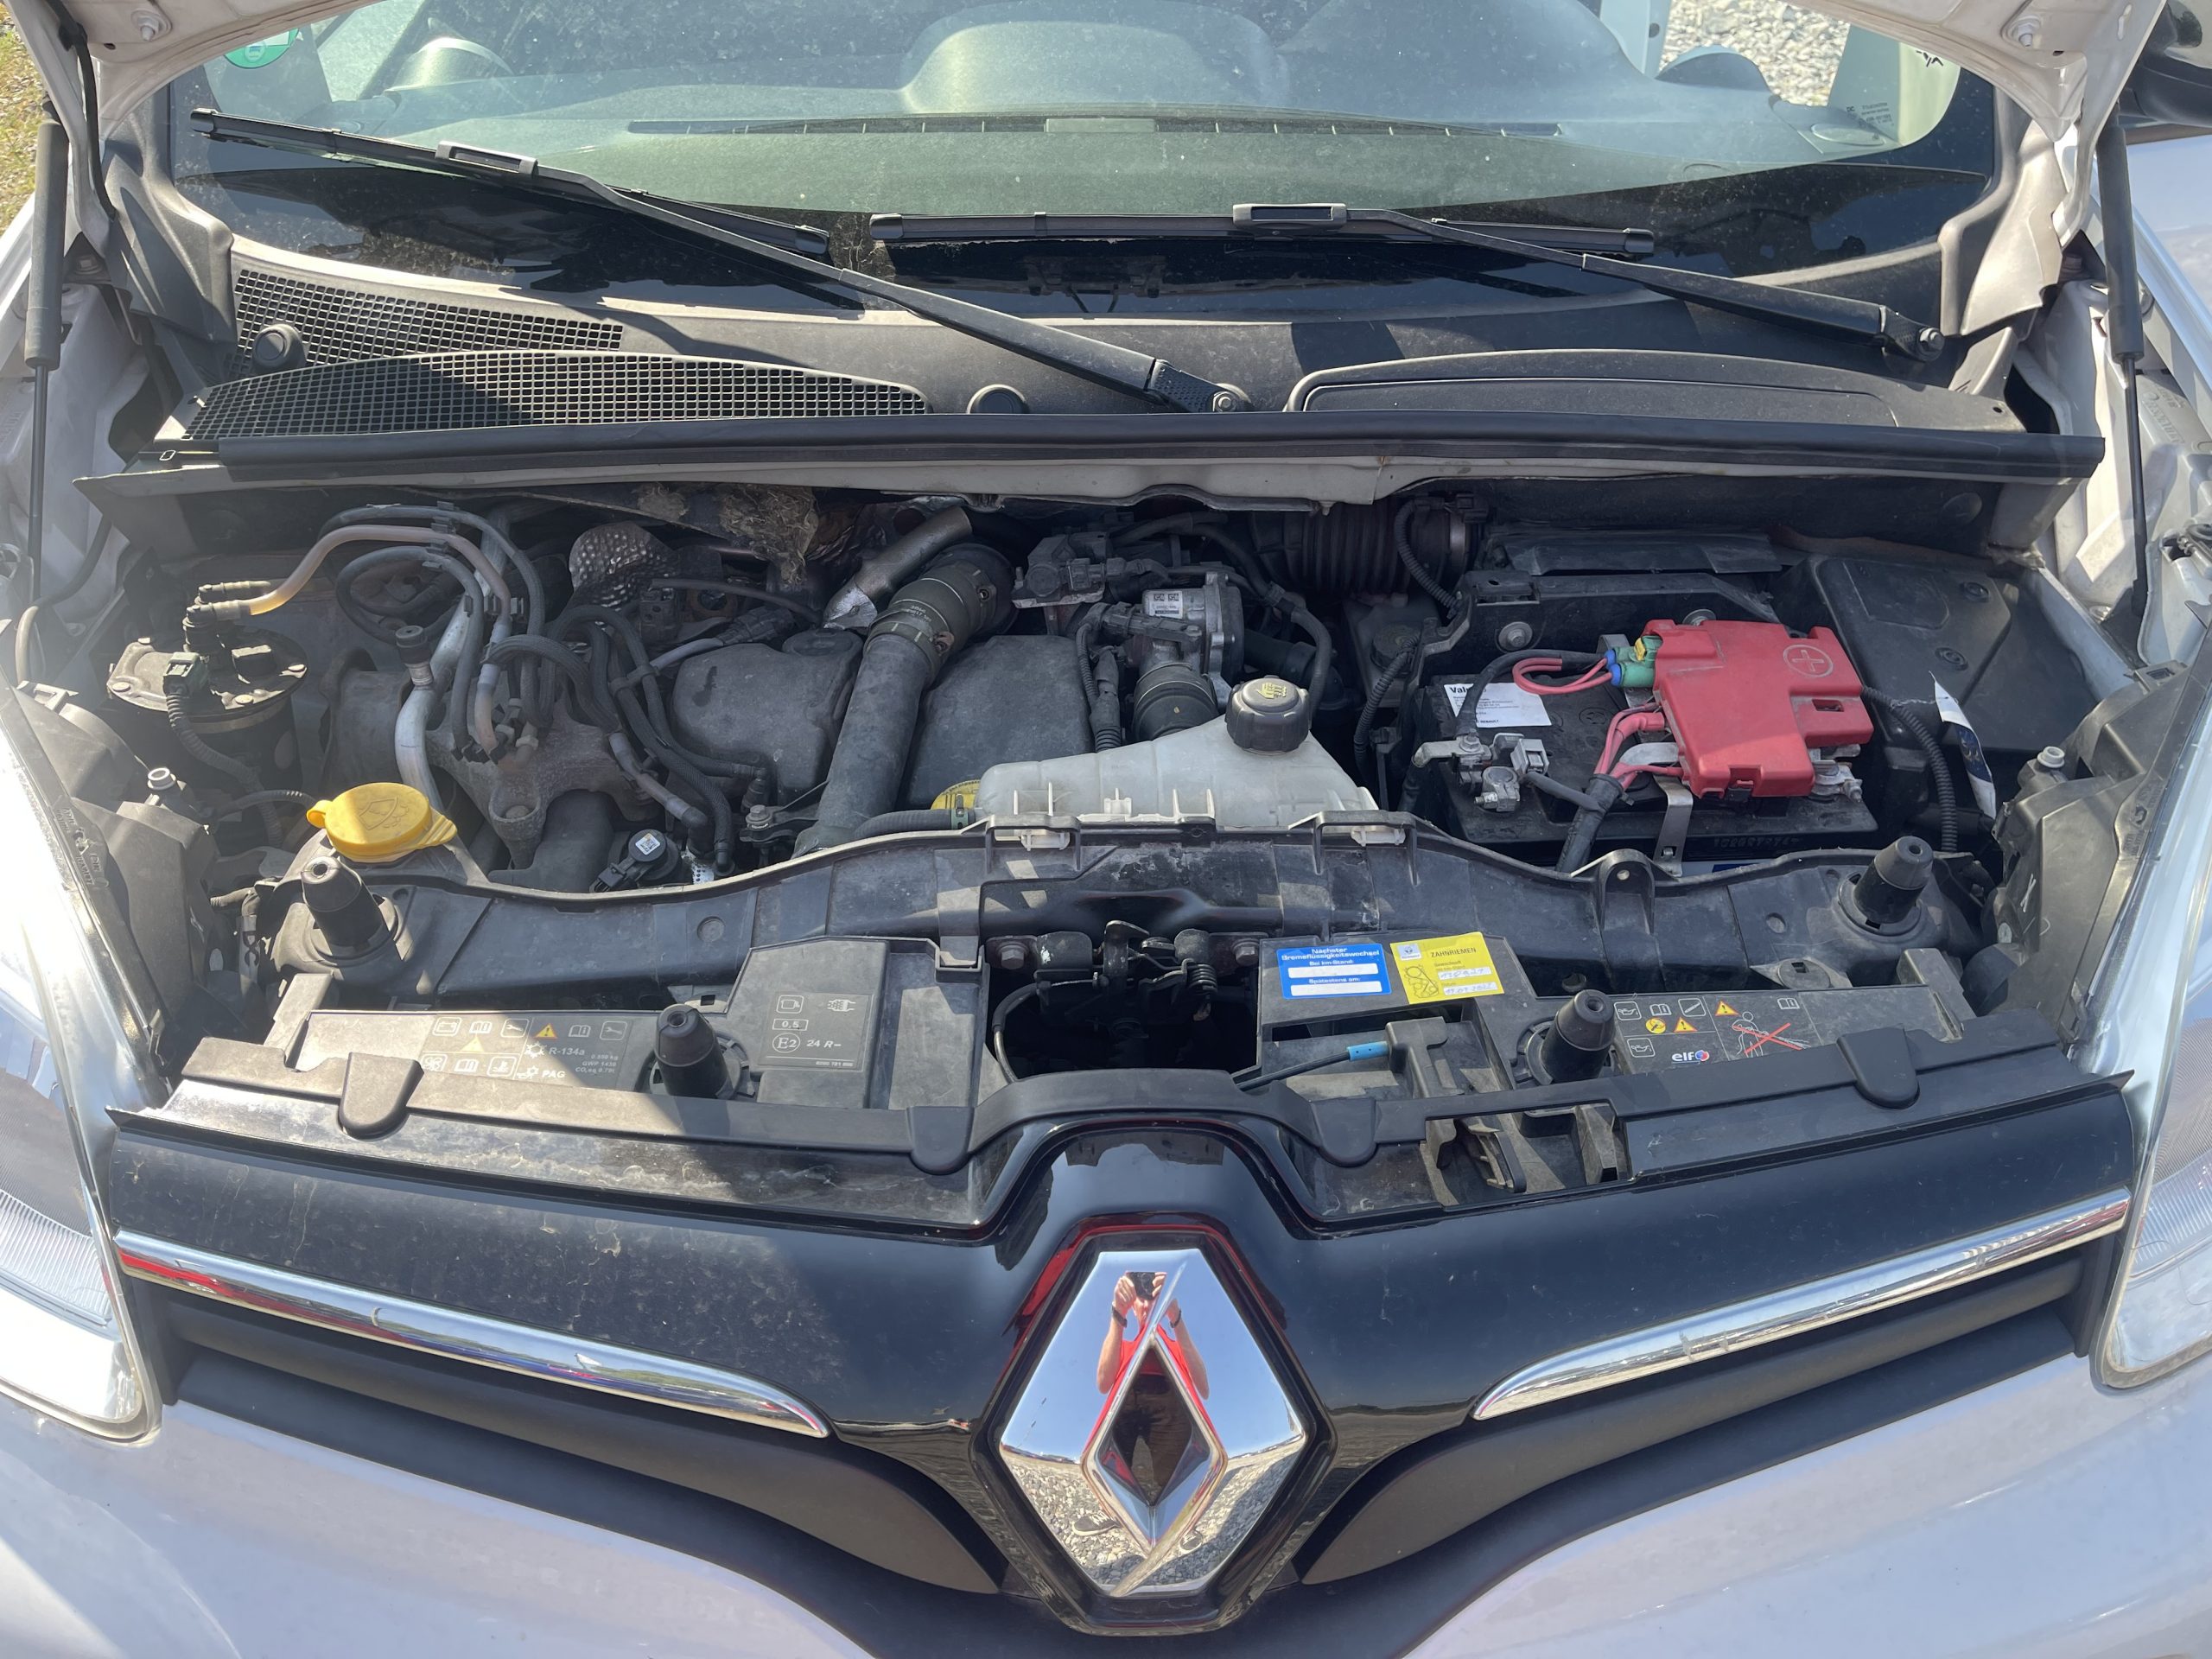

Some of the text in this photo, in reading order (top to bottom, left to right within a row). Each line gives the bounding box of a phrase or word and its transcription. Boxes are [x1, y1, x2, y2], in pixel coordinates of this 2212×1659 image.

[1431, 947, 1478, 957] ZAHNRIEMEN
[777, 1037, 797, 1049] E2
[549, 1047, 585, 1056] R-134a
[541, 1070, 566, 1078] PAG
